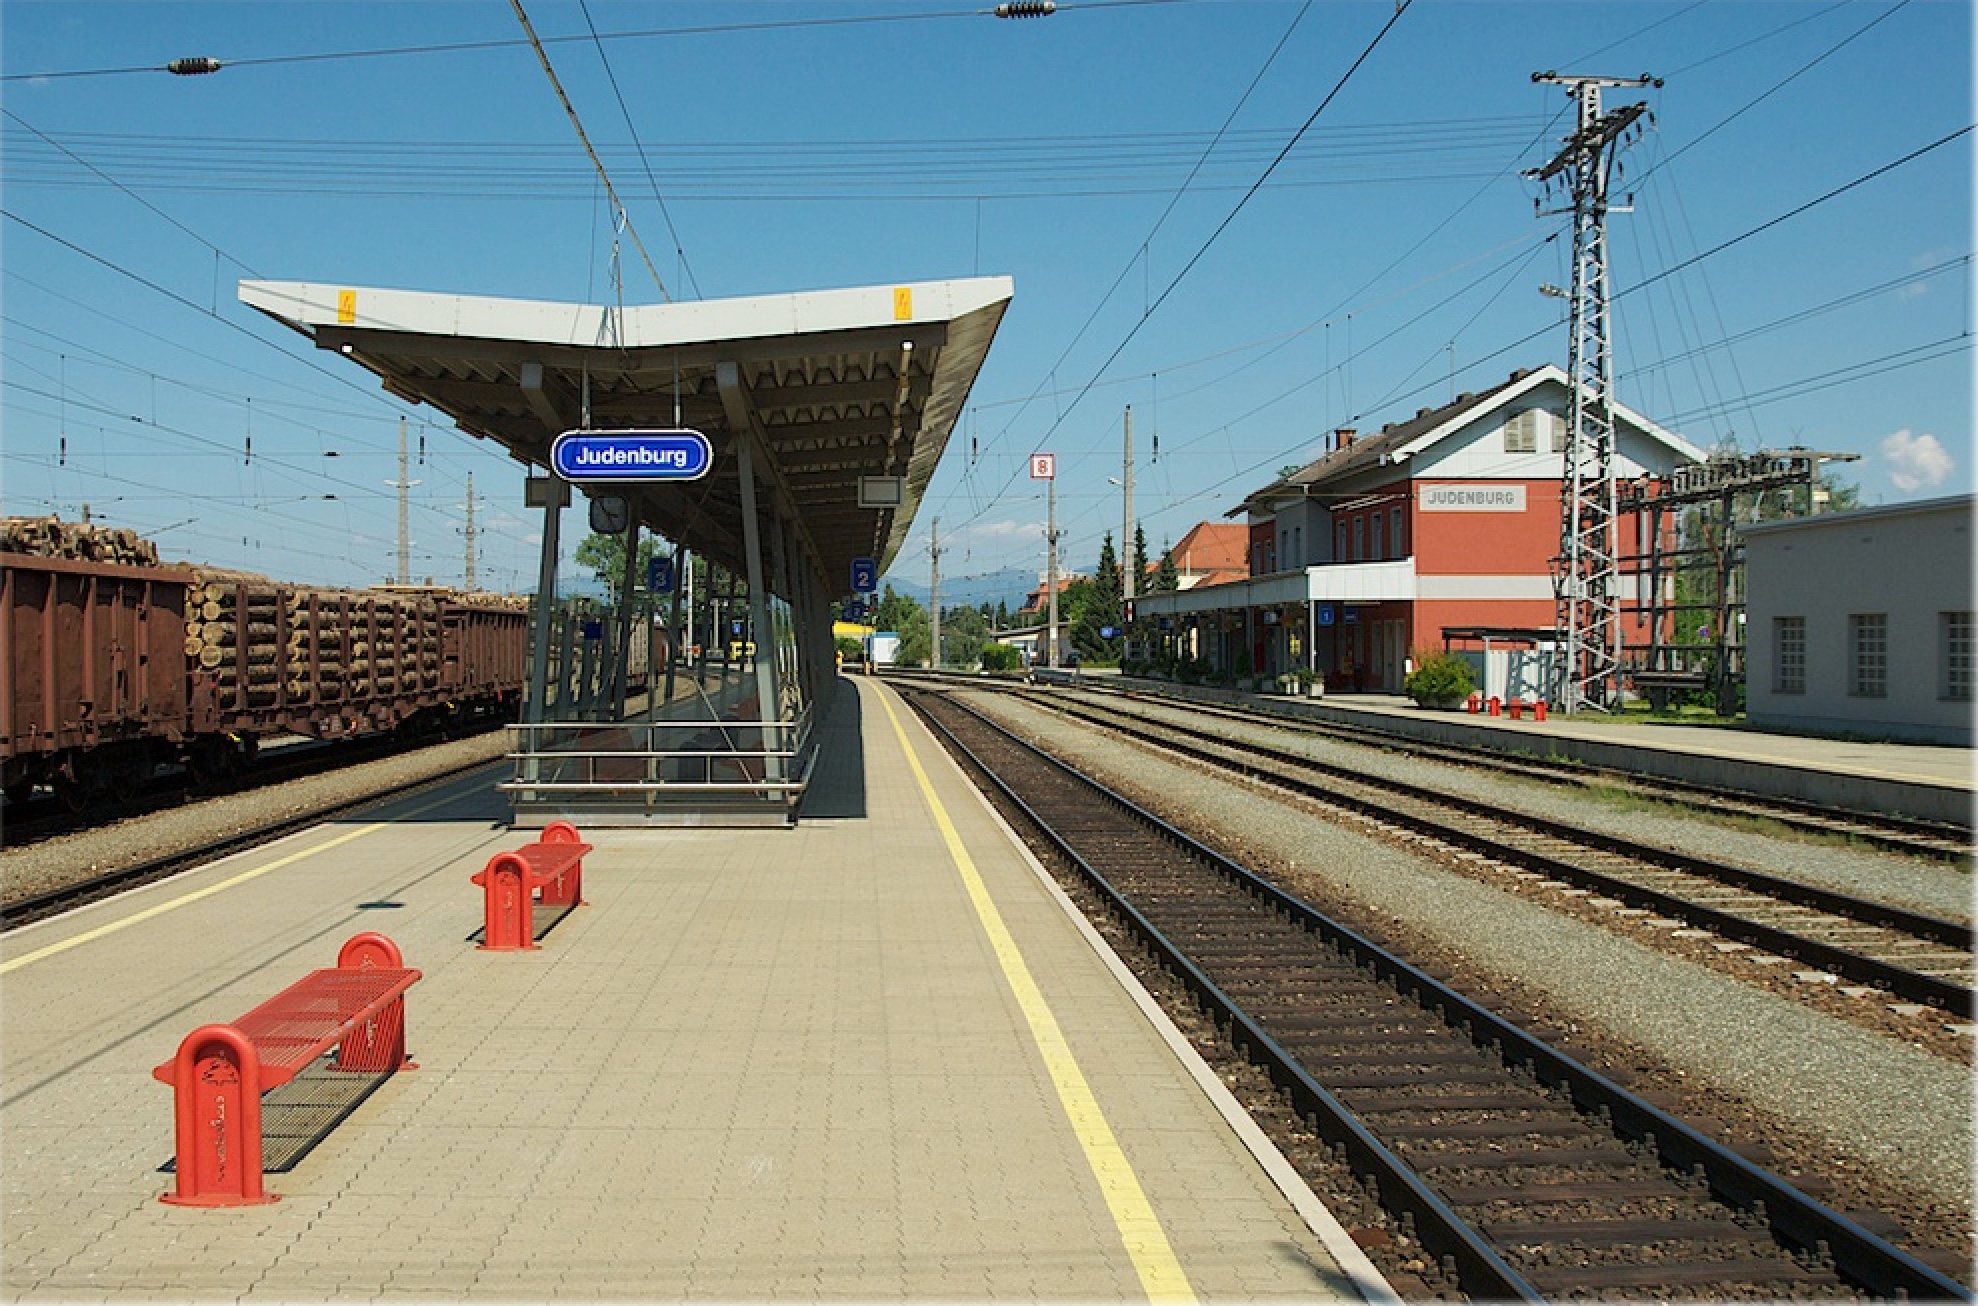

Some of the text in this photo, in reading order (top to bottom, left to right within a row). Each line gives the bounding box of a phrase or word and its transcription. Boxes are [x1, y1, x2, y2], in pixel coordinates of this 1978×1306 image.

[576, 446, 687, 468] Judenburg
[1038, 460, 1047, 474] 8
[1428, 492, 1514, 504] JUDENBURG
[858, 572, 869, 587] 2
